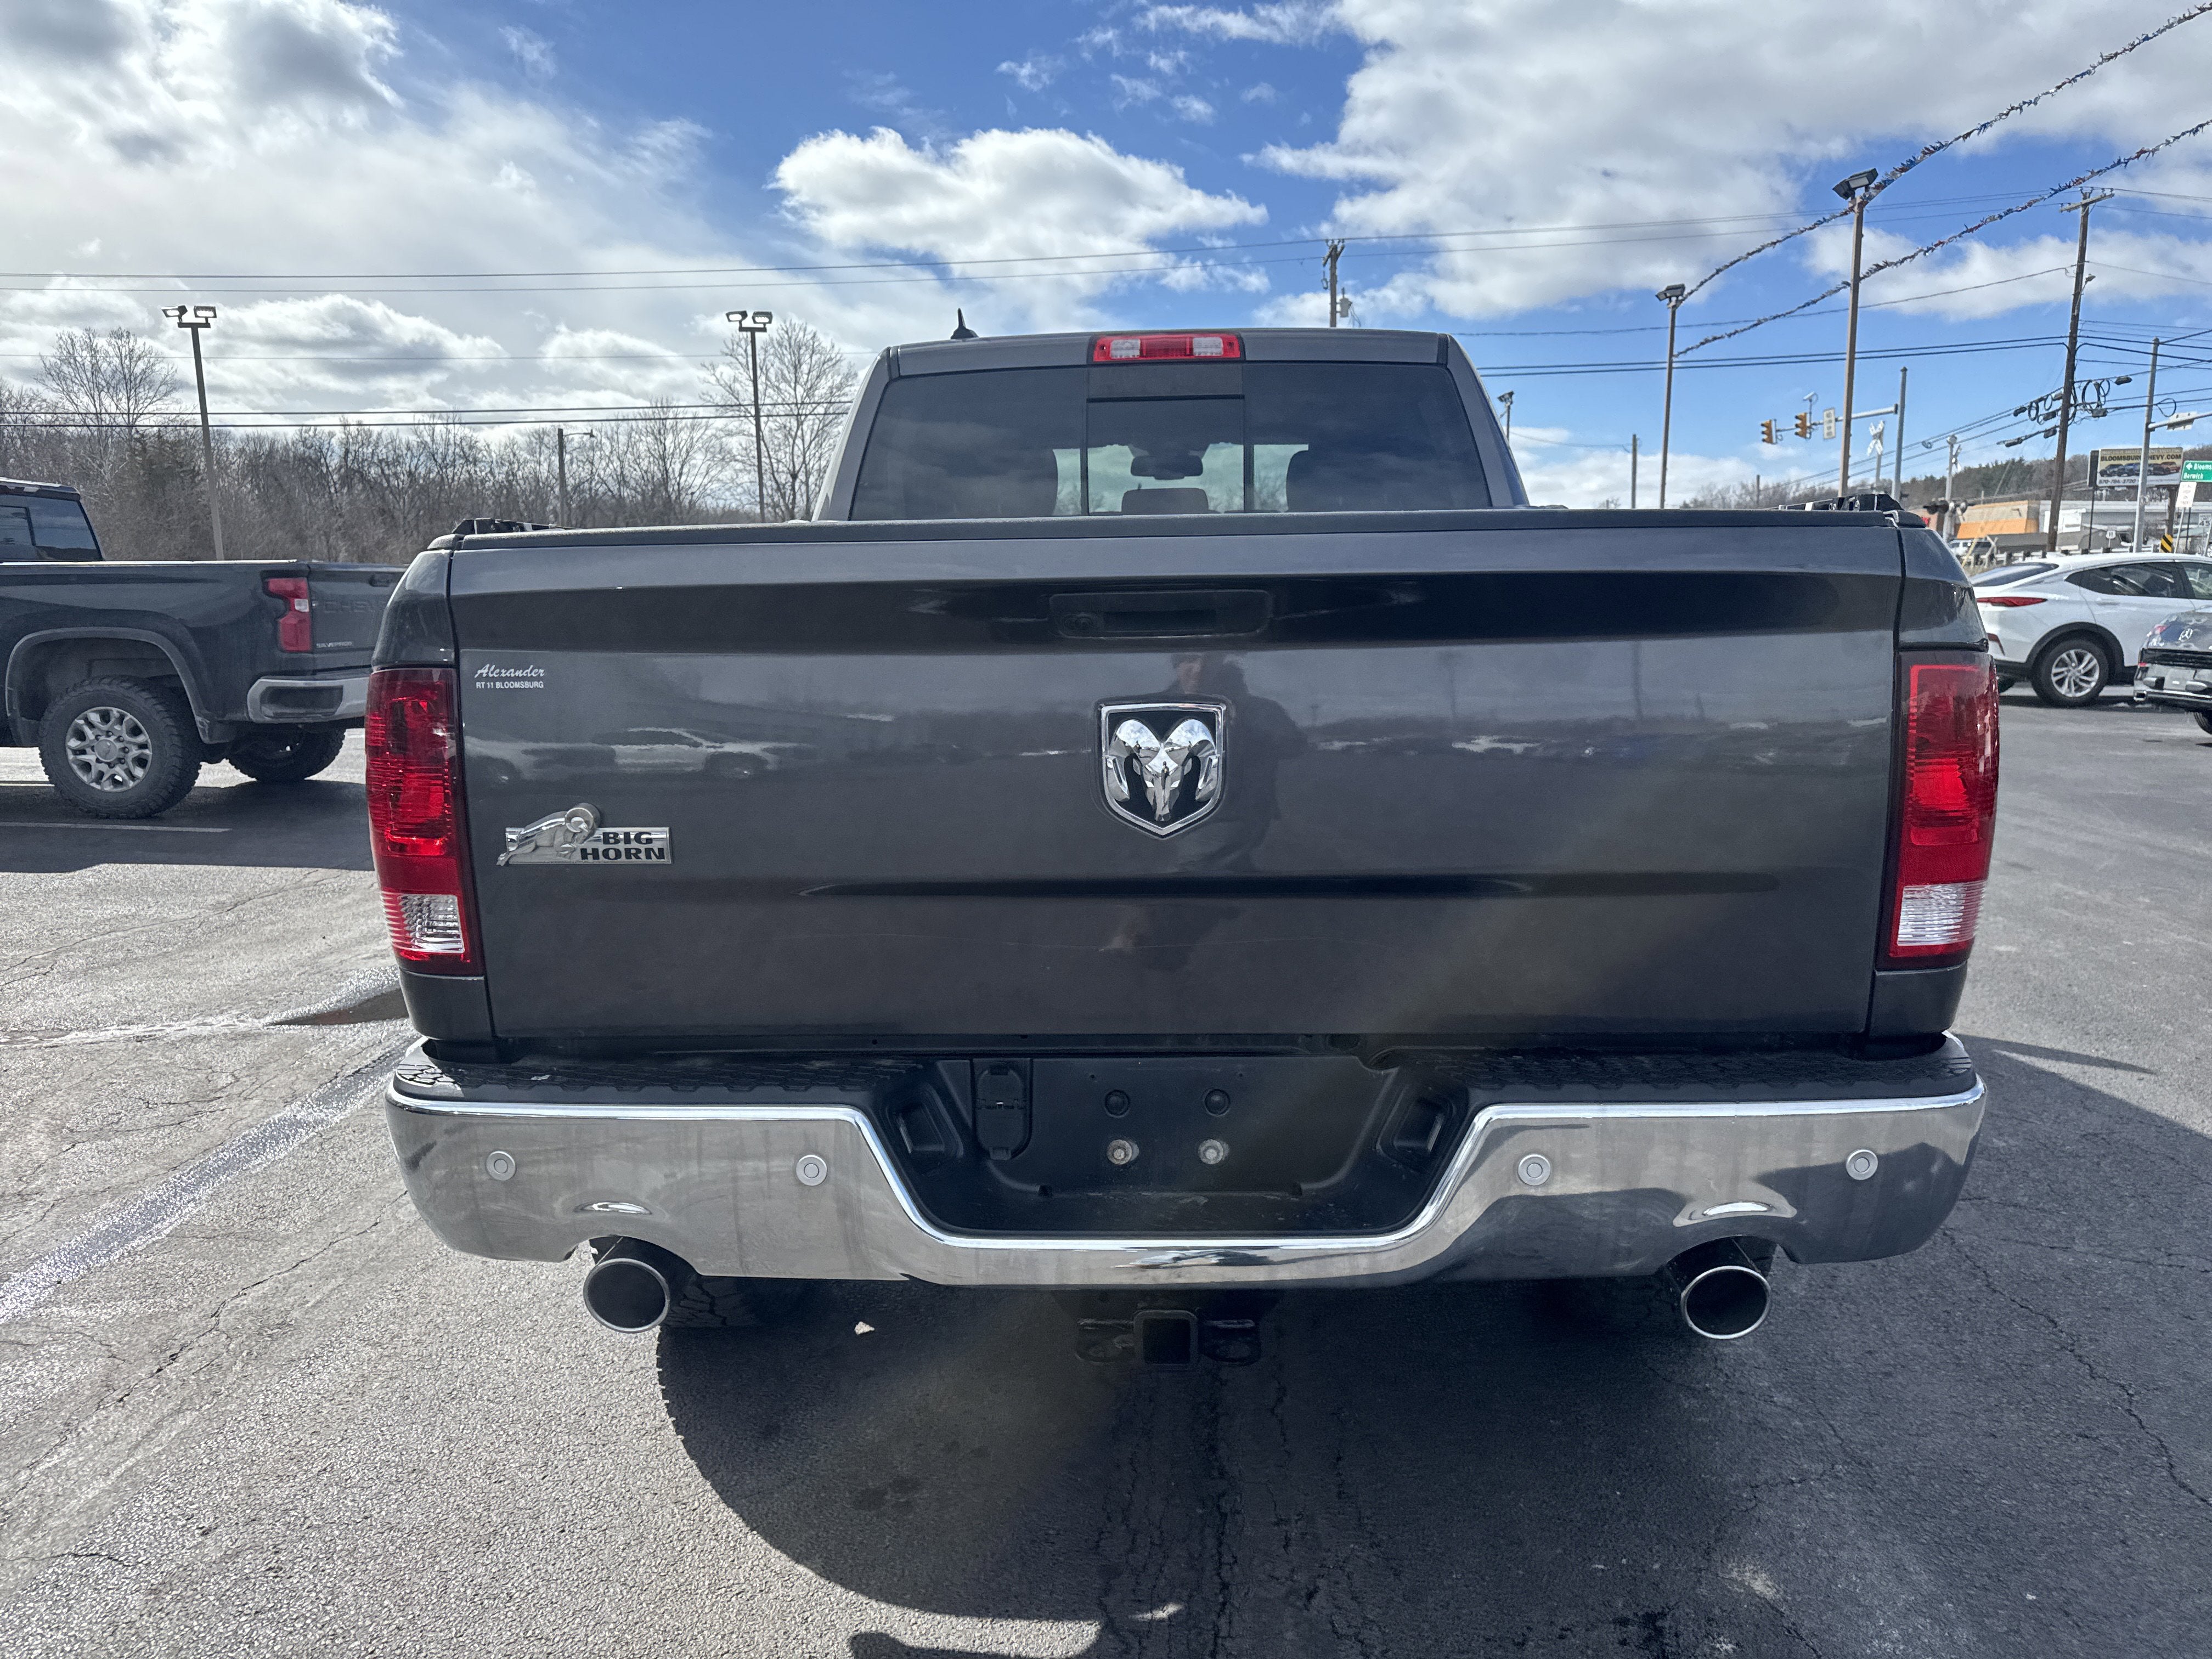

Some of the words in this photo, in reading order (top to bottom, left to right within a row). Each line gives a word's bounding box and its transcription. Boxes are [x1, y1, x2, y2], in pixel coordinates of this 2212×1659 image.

[474, 663, 545, 678] Alexander
[602, 832, 653, 845] BIG
[580, 848, 666, 861] HORN
